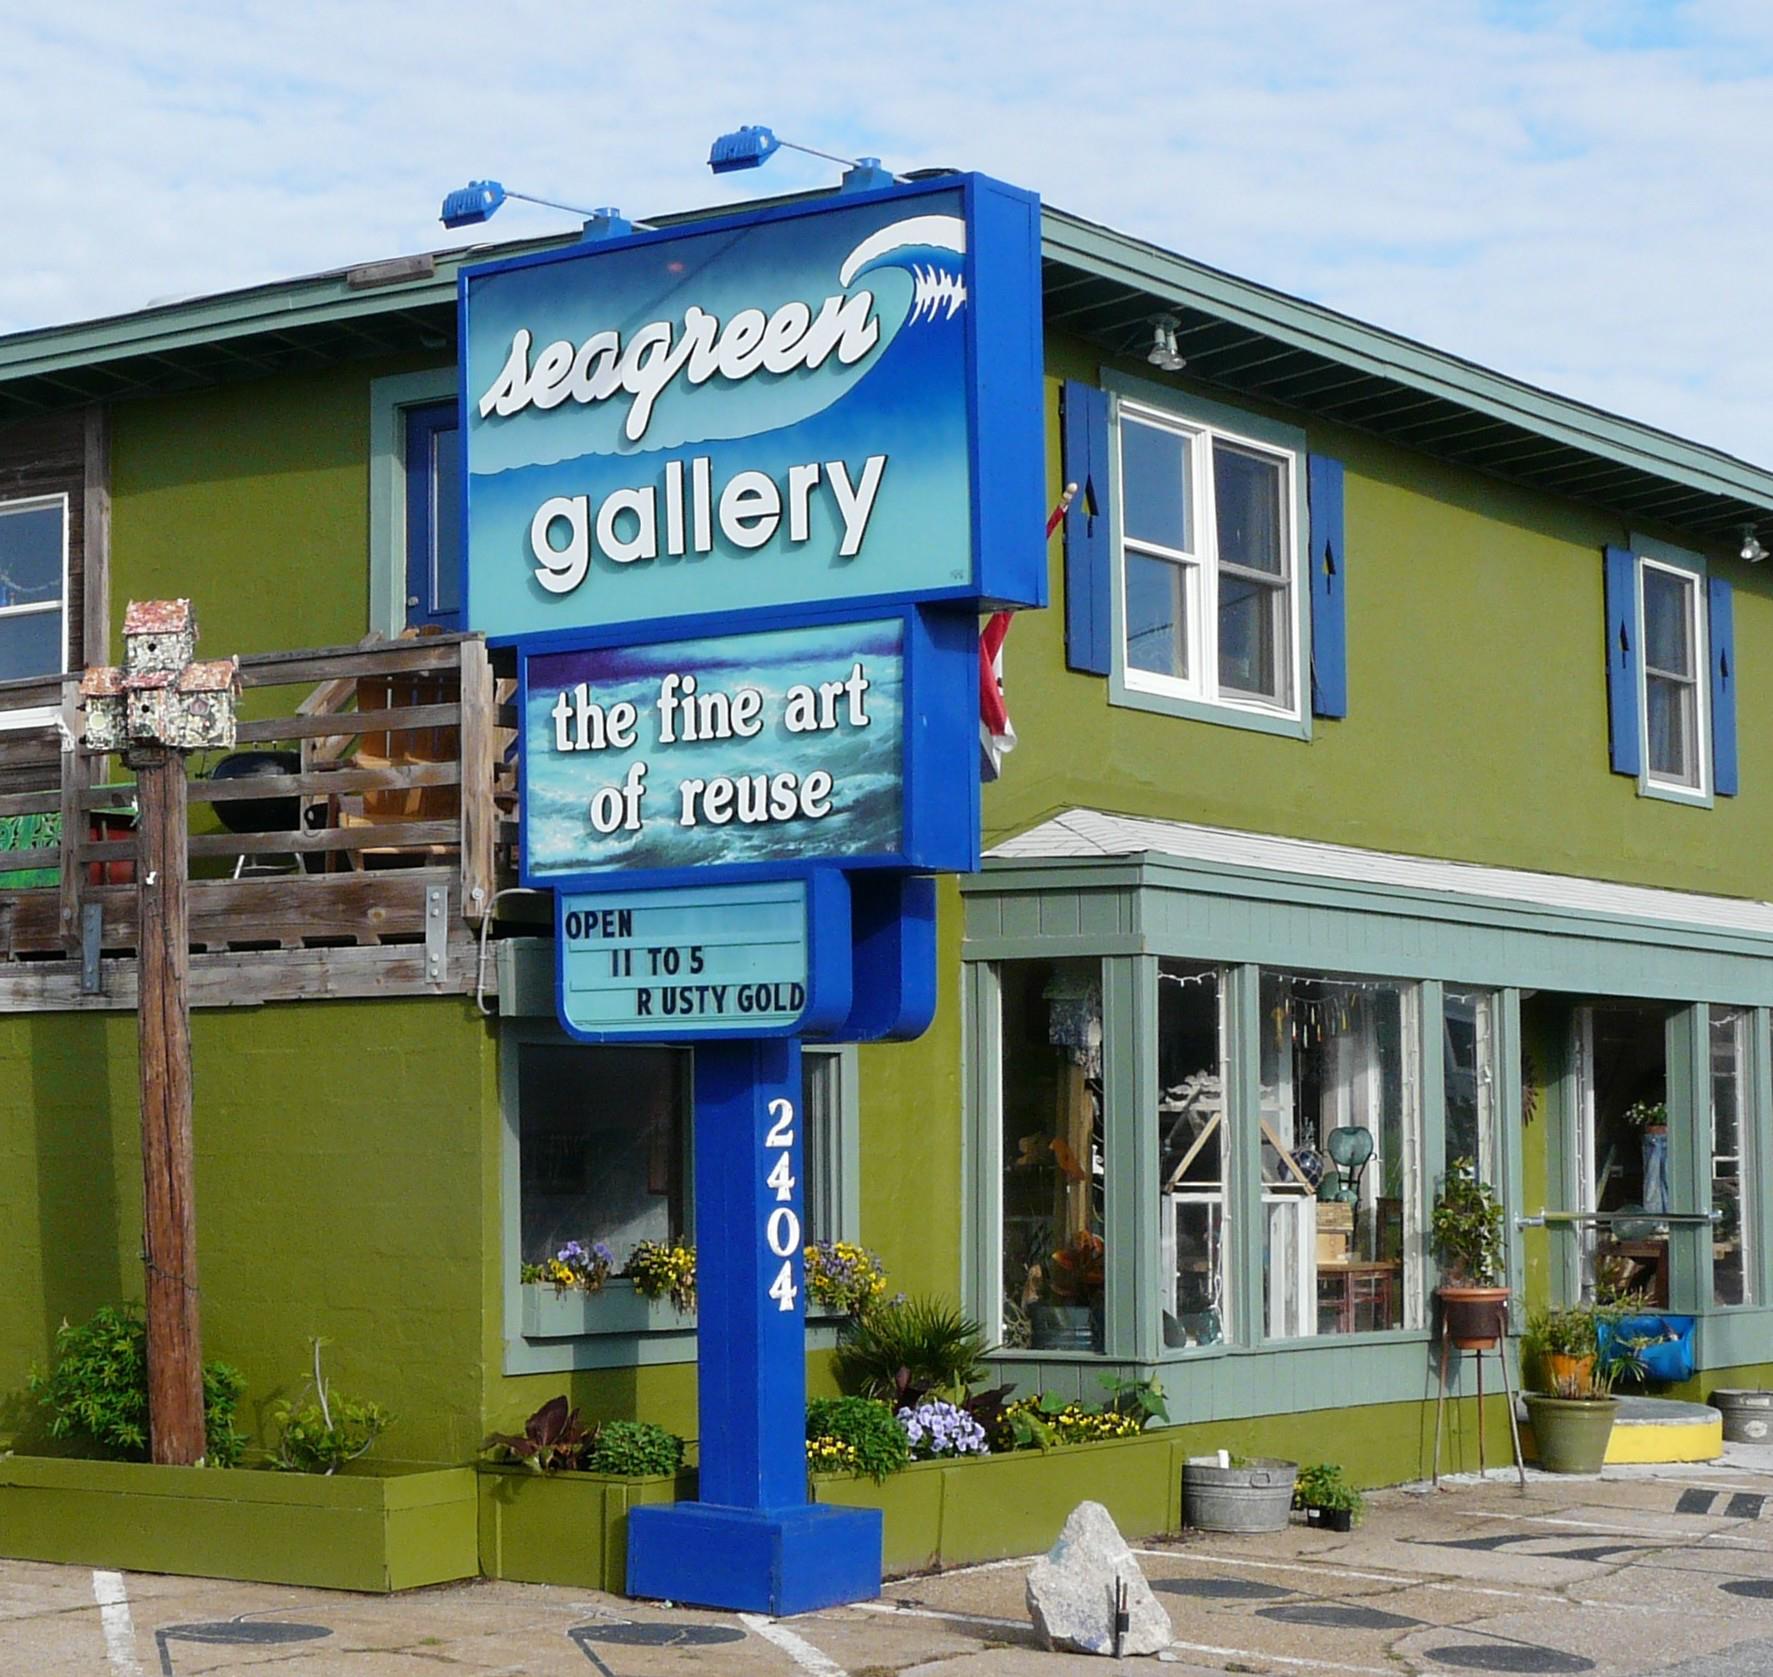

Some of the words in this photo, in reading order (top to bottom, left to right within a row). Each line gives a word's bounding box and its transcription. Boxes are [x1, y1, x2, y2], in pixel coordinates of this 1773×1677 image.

[479, 289, 880, 442] seagreen
[530, 454, 888, 594] gallery
[551, 682, 638, 752] the
[657, 673, 763, 743] fine
[784, 663, 870, 732] art
[590, 761, 649, 833] of
[680, 769, 833, 827] reuse
[565, 909, 632, 939] OPEN
[647, 946, 680, 976] TO
[690, 945, 704, 974] 5
[737, 982, 805, 1013] GOLD
[765, 1098, 800, 1312] 2404
